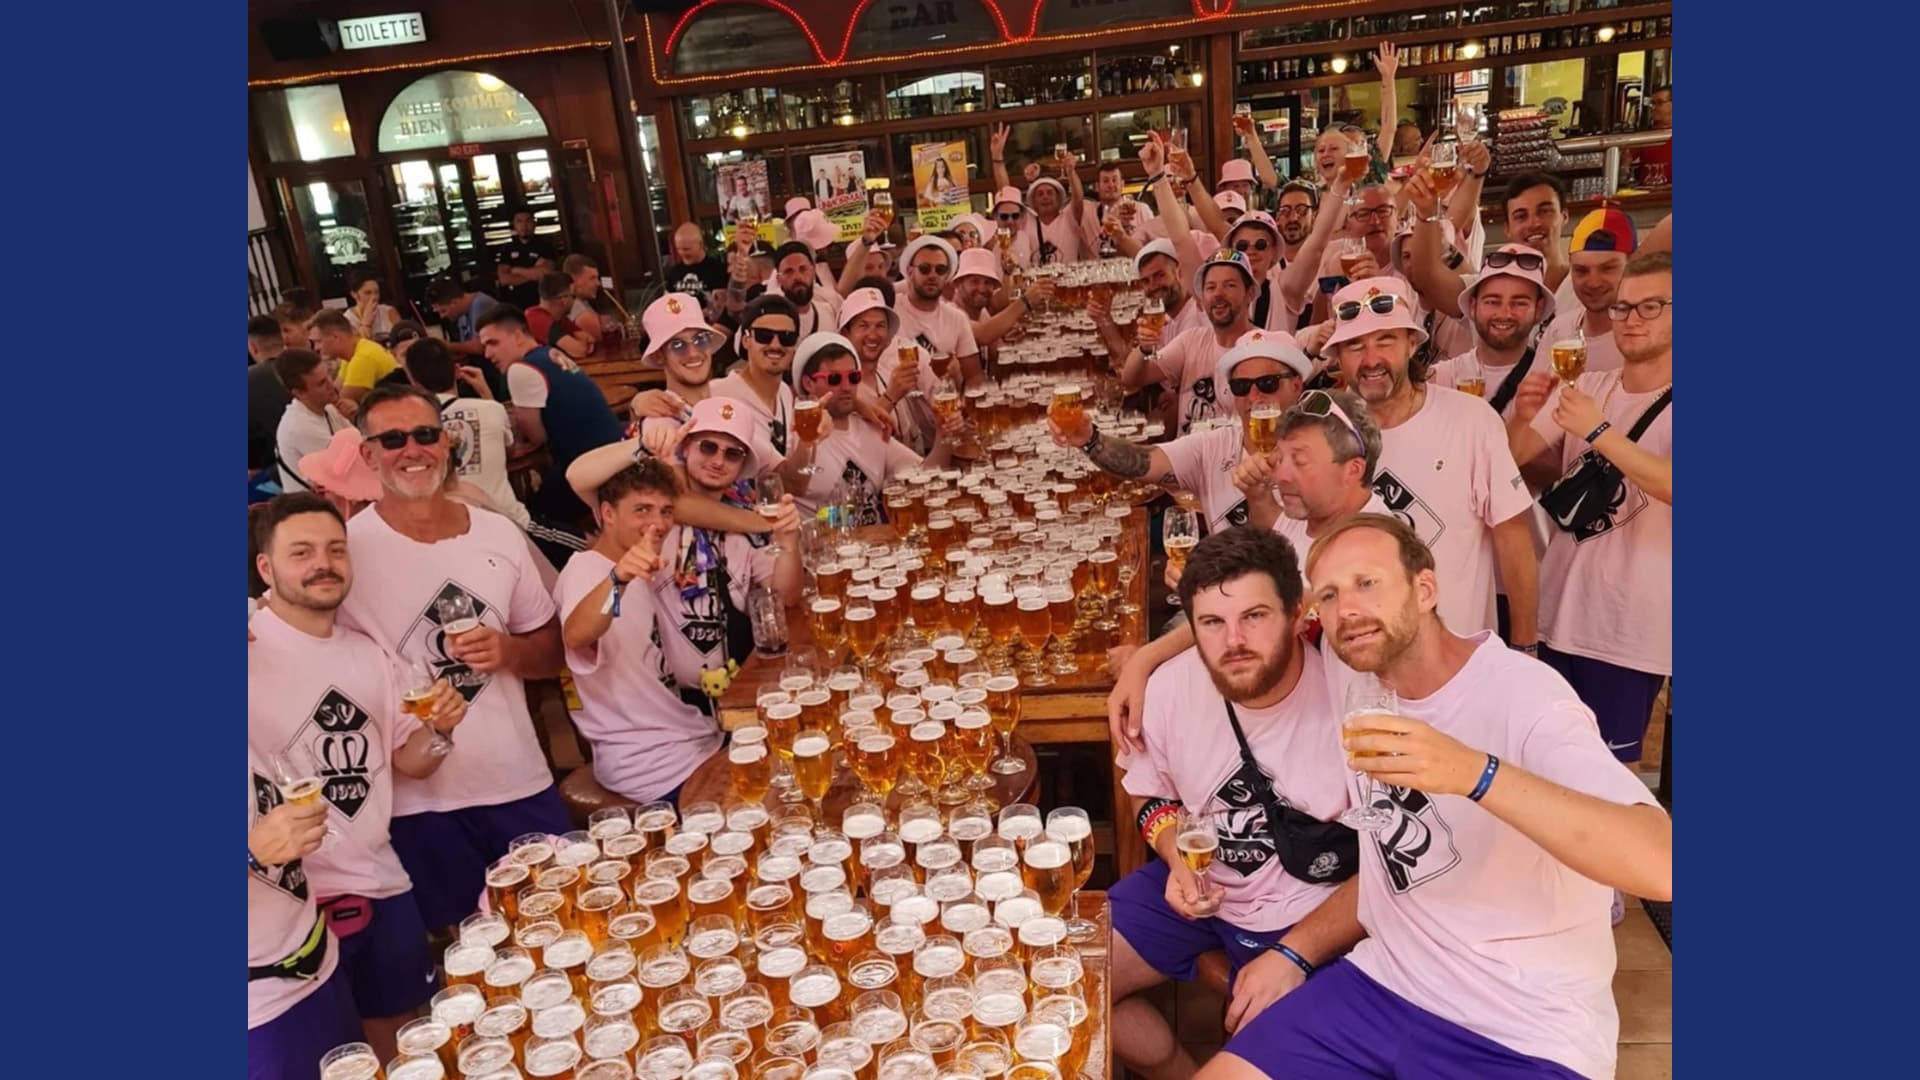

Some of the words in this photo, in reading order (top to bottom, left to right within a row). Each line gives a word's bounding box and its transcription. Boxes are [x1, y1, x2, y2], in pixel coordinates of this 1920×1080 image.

[343, 18, 420, 42] TOILETTE
[1234, 507, 1248, 525] S
[320, 702, 356, 727] SV
[328, 782, 366, 801] 1920
[1217, 846, 1266, 863] 1920
